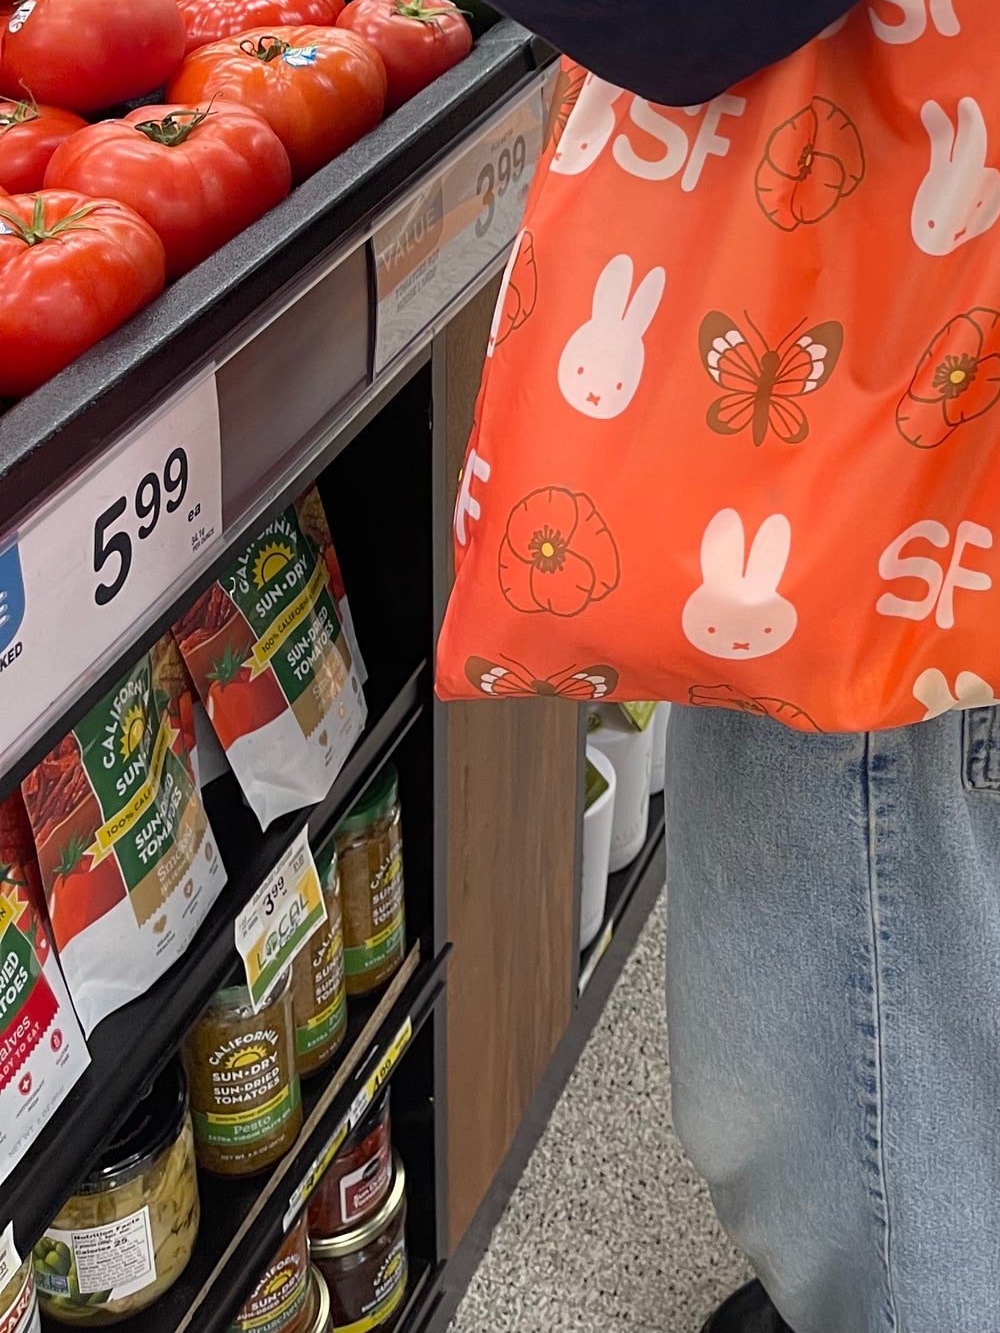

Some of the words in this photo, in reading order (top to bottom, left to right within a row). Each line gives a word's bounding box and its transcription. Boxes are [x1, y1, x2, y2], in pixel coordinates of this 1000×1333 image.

[613, 94, 746, 192] SF
[475, 134, 526, 239] 399
[378, 206, 436, 272] VALUE
[94, 447, 189, 606] 599
[187, 503, 202, 522] ea
[877, 519, 994, 630] SF
[293, 619, 334, 681] TOMATOES
[107, 812, 135, 838] 100%
[263, 875, 285, 916] 399
[14, 1042, 27, 1059] TO
[27, 1021, 41, 1043] EAT
[209, 1029, 279, 1066] CALIFORNIA
[213, 1067, 280, 1096] SUN-DRIED
[214, 1076, 280, 1105] TOMATOES
[233, 1115, 271, 1135] Pesto
[73, 1228, 114, 1241] Nutrition
[116, 1217, 140, 1232] Facts
[75, 1245, 111, 1256] Calories
